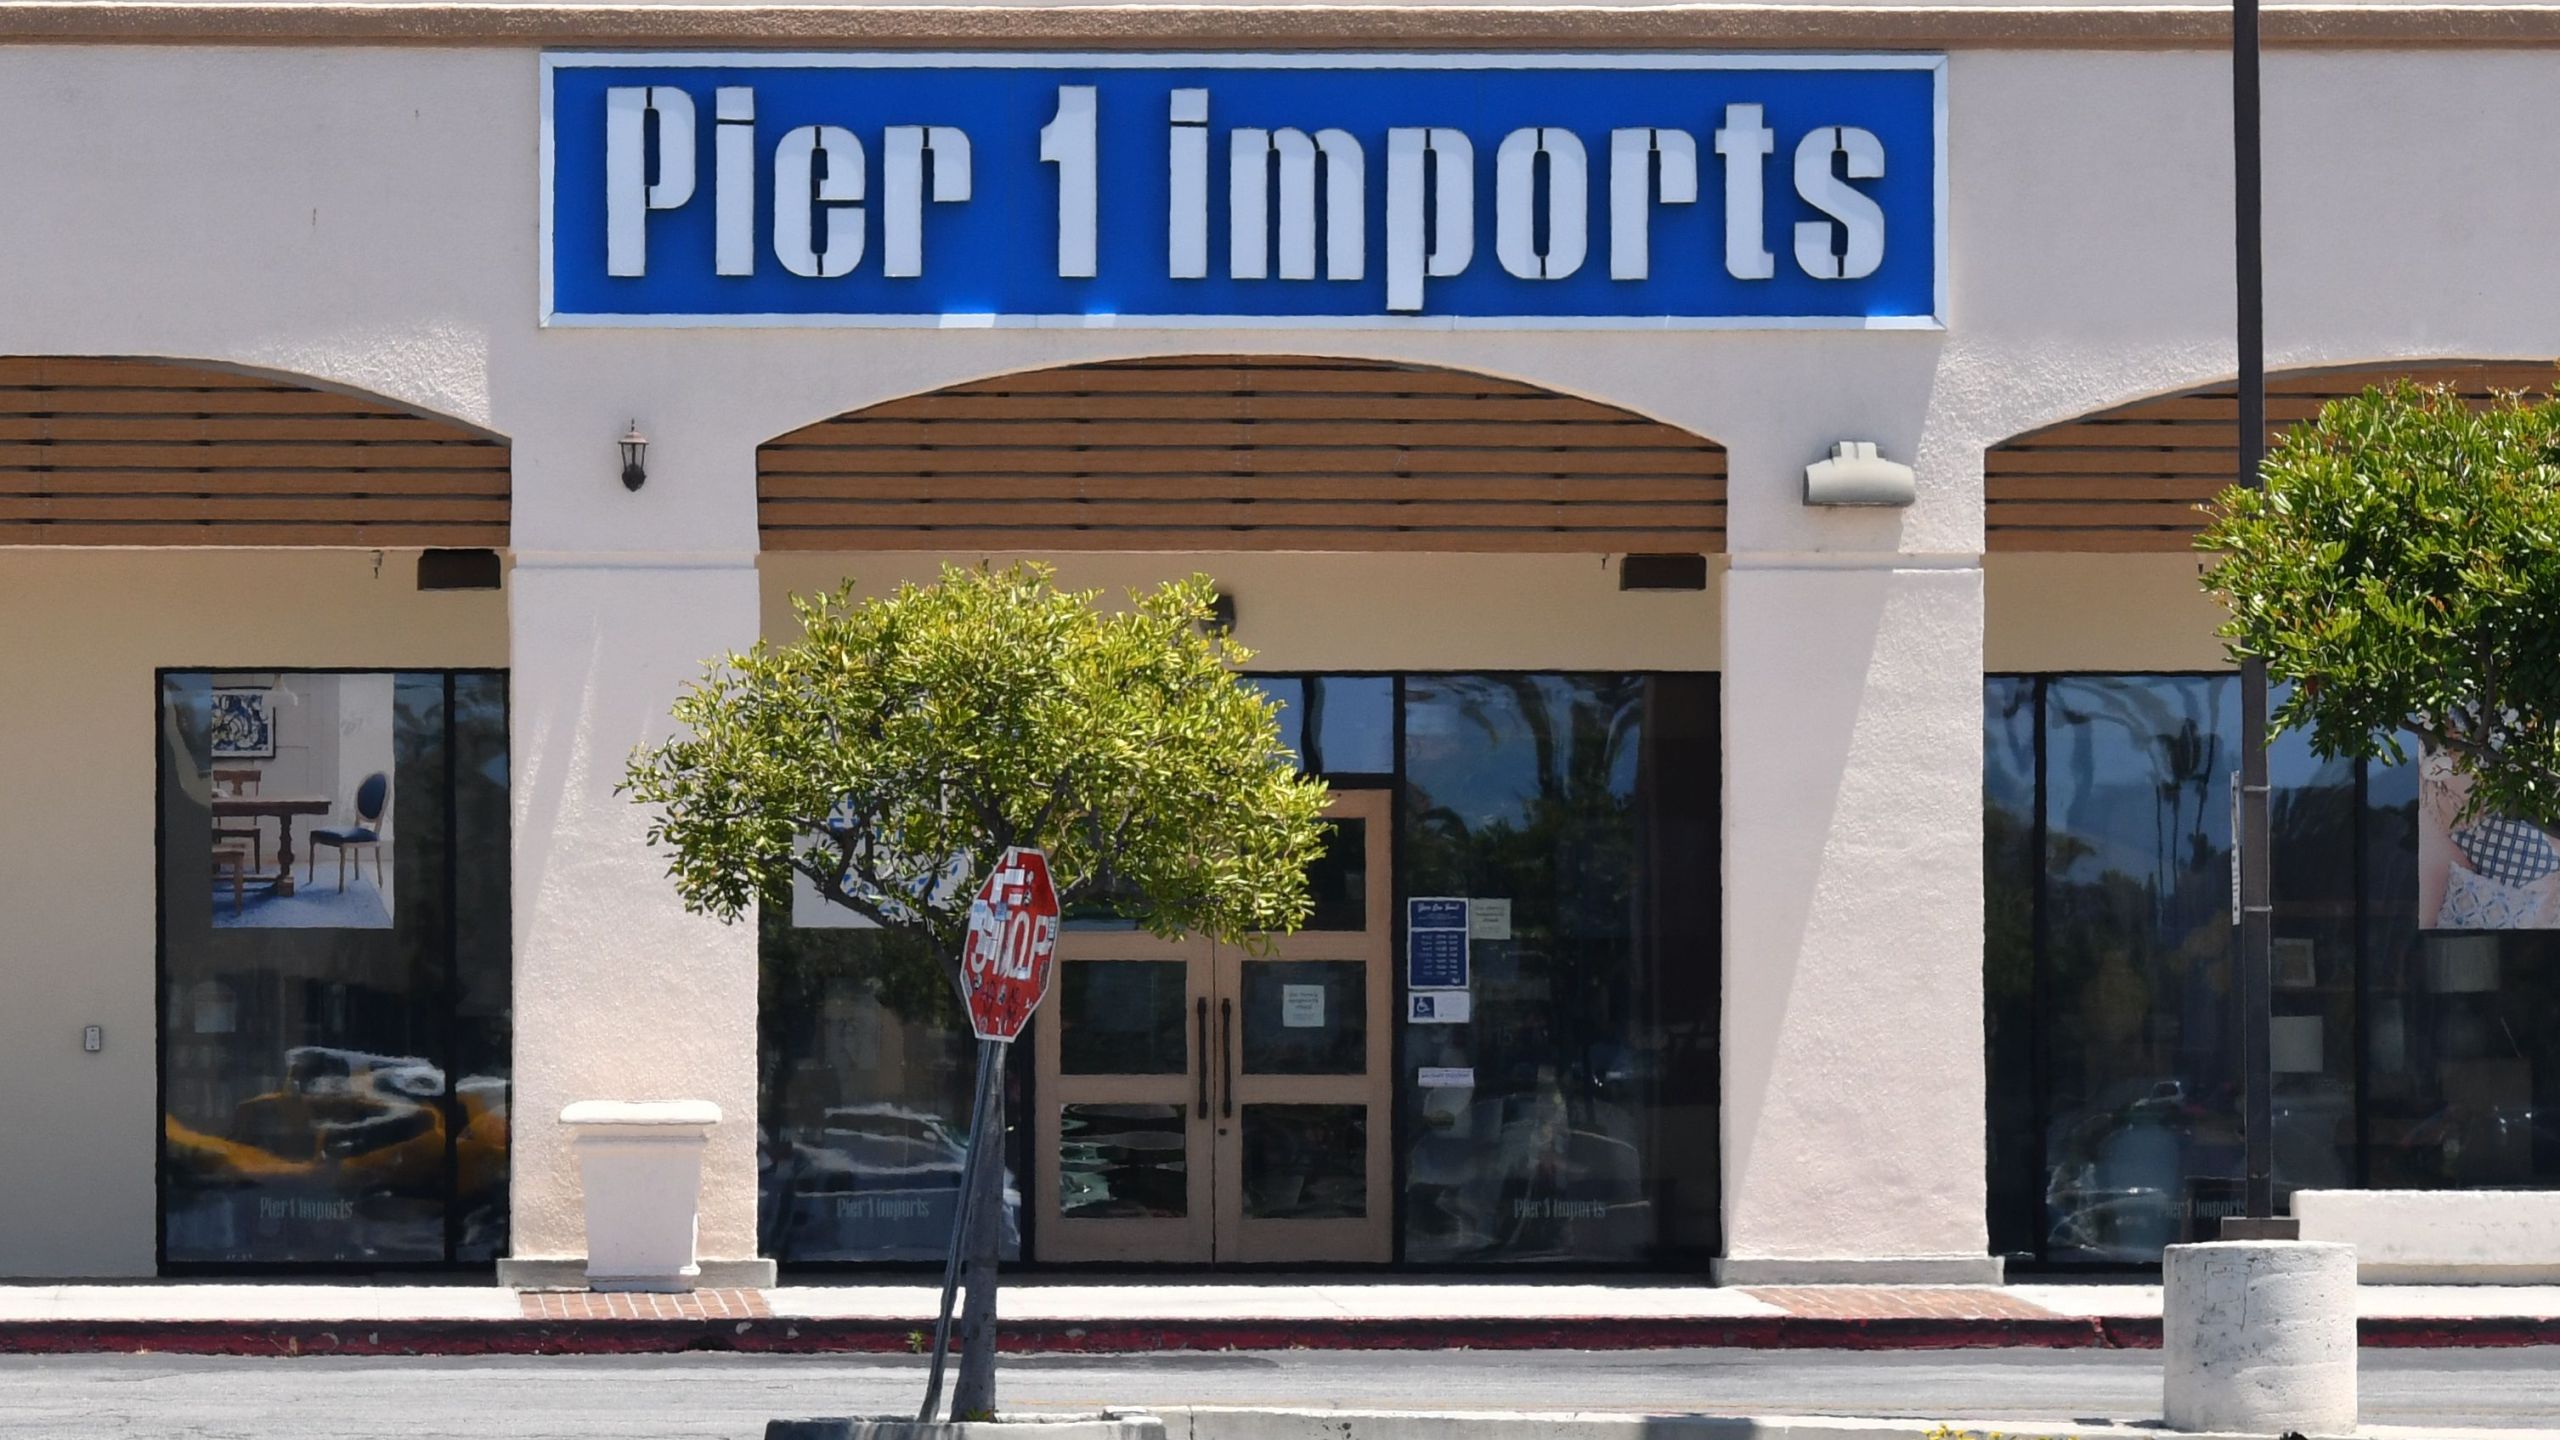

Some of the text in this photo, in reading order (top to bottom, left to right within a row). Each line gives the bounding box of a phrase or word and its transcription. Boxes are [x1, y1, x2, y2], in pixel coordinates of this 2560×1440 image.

[607, 86, 1886, 310] Pier 1 imports
[969, 909, 1053, 979] STOP
[259, 1197, 288, 1219] Pier
[837, 1197, 865, 1218] Pier
[1513, 1198, 1542, 1219] Pier
